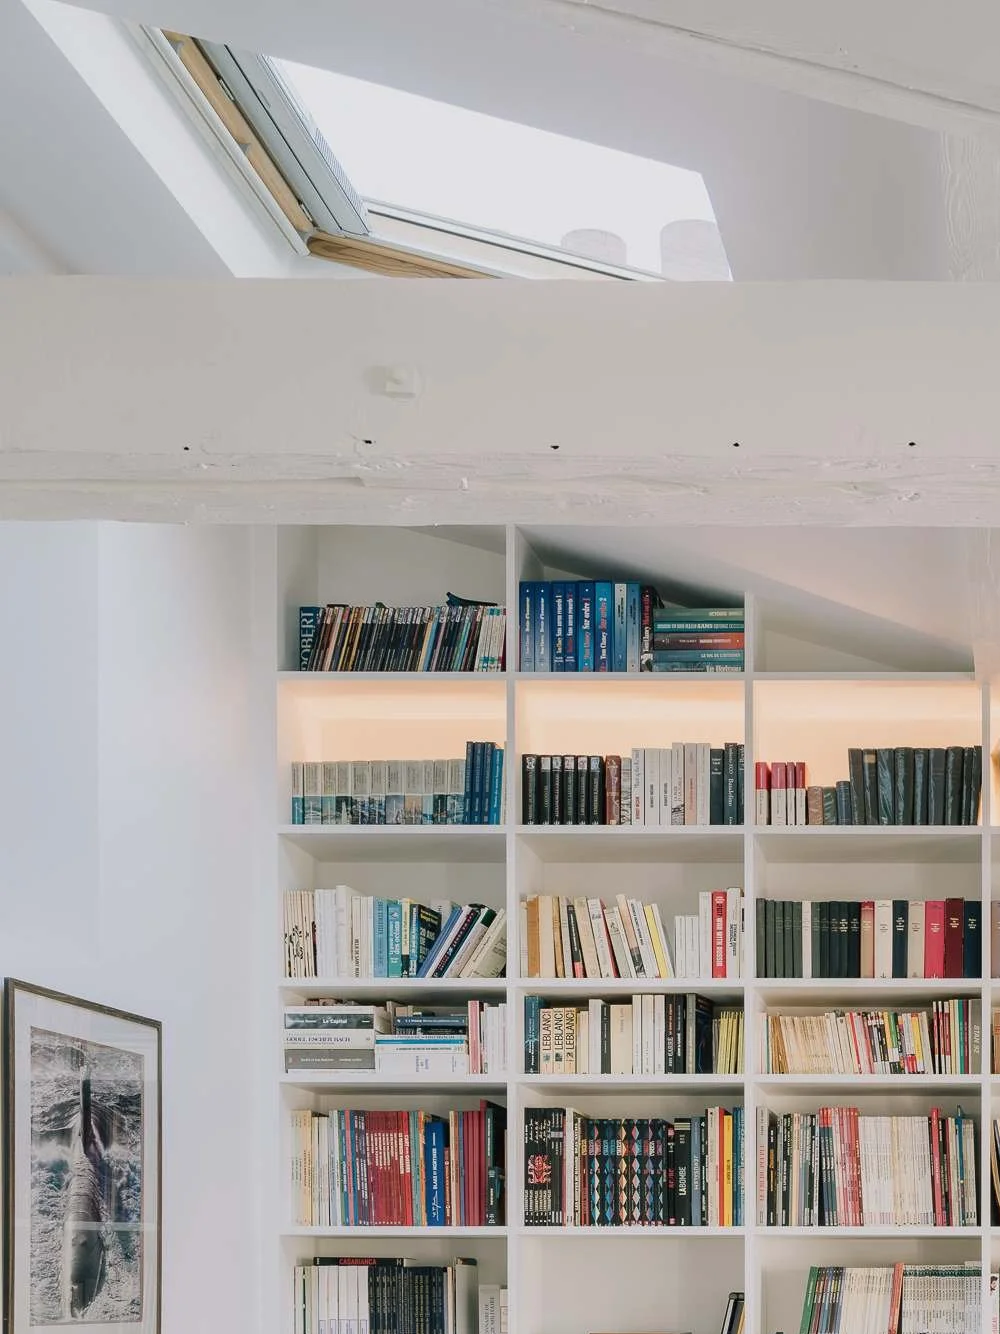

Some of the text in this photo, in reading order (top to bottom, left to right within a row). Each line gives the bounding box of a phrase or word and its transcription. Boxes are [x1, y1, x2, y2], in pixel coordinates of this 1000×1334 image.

[542, 1012, 551, 1050] LEBLANC
[554, 1012, 563, 1050] LEBLANC
[564, 1011, 574, 1050] LEBLANC
[678, 1166, 686, 1187] BOMBE
